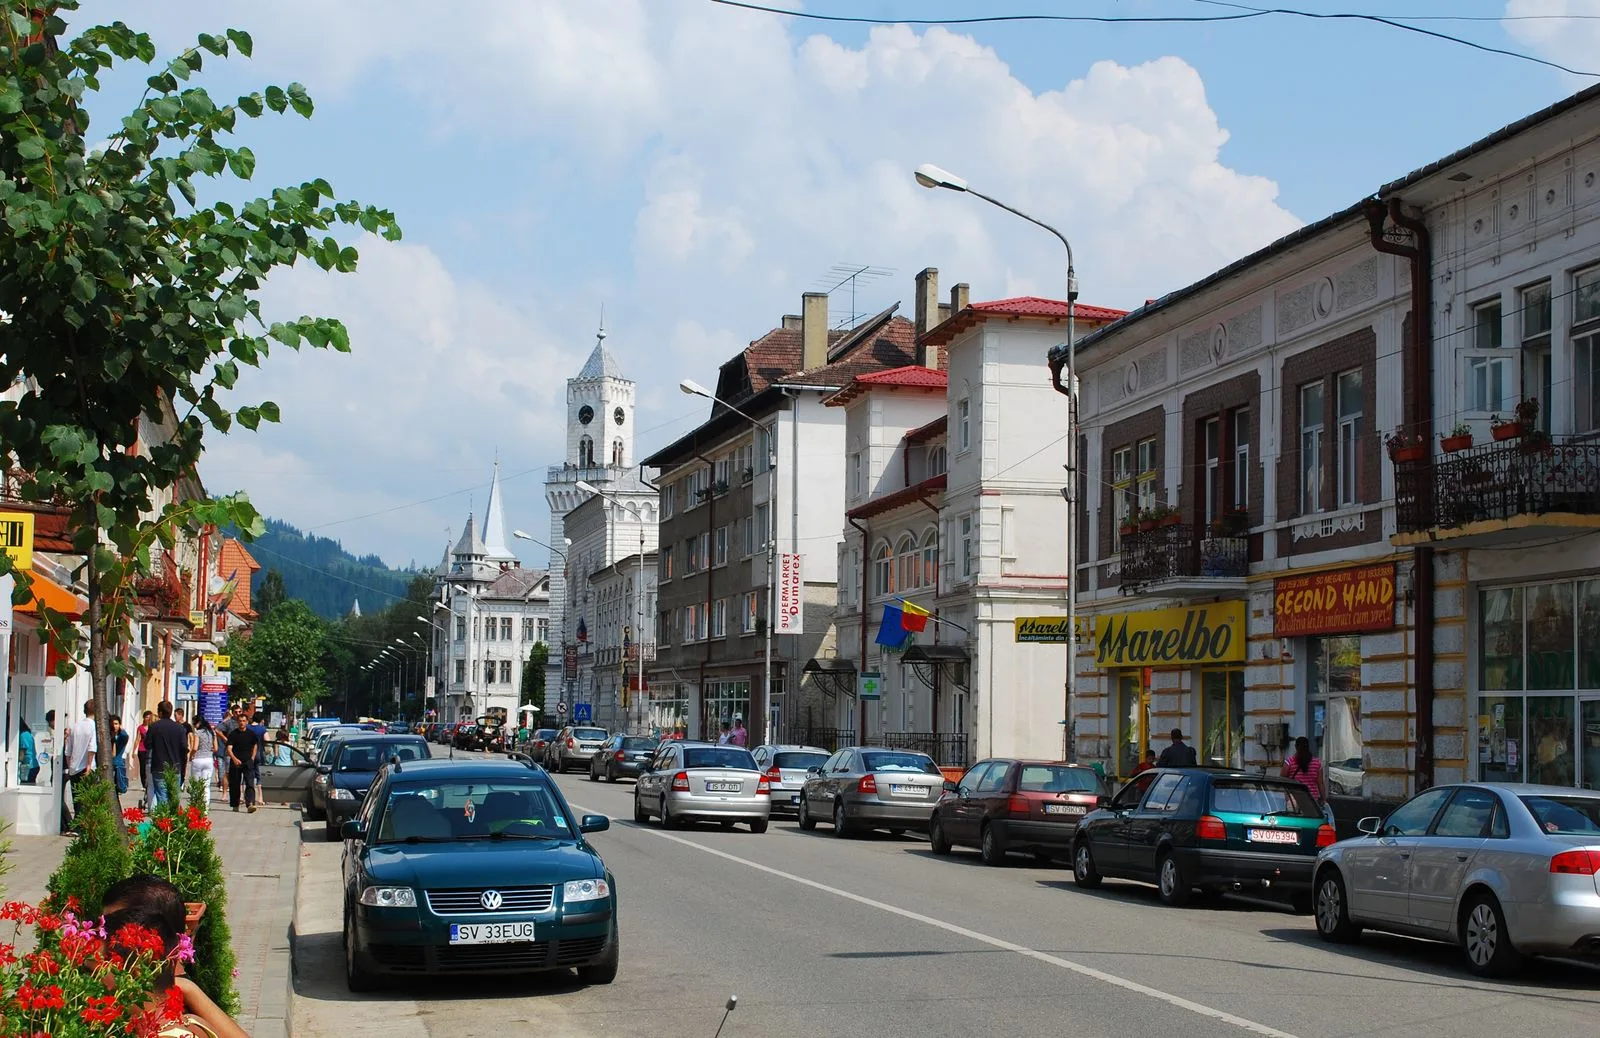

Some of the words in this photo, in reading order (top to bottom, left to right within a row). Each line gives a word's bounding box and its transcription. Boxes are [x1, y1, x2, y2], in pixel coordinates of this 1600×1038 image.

[781, 554, 790, 629] SUPERMARKET
[789, 554, 800, 615] Dumarex
[1276, 585, 1337, 616] SECOND
[1343, 577, 1393, 612] HAND
[1097, 609, 1232, 663] Marelbo
[1050, 805, 1060, 813] SV
[1253, 830, 1264, 839] SV
[460, 926, 479, 940] SV
[485, 924, 533, 939] 33EUG
